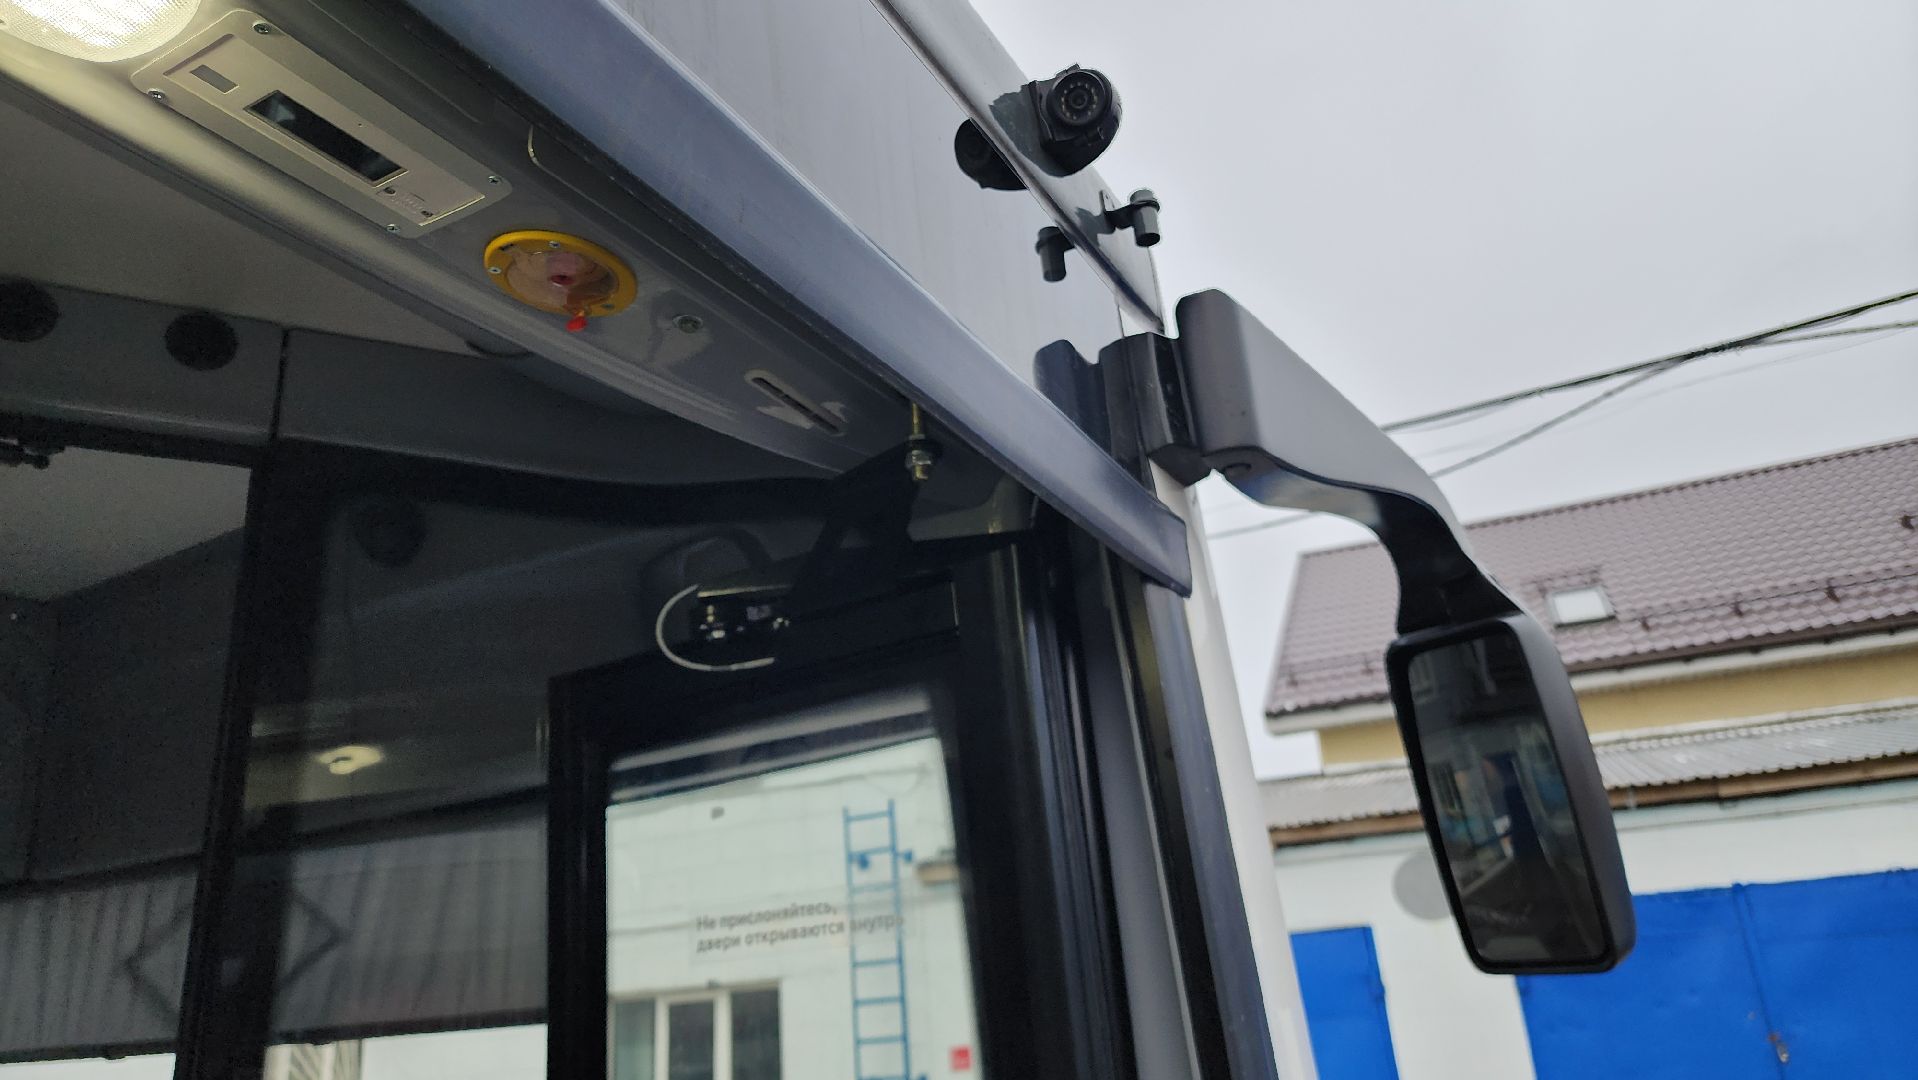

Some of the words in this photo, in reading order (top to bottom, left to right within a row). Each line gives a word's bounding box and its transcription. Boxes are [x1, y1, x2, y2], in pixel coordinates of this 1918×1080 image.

[696, 916, 716, 931] Не
[719, 902, 837, 930] прислоняйтесь,
[696, 936, 741, 953] двери
[745, 920, 844, 945] открываются
